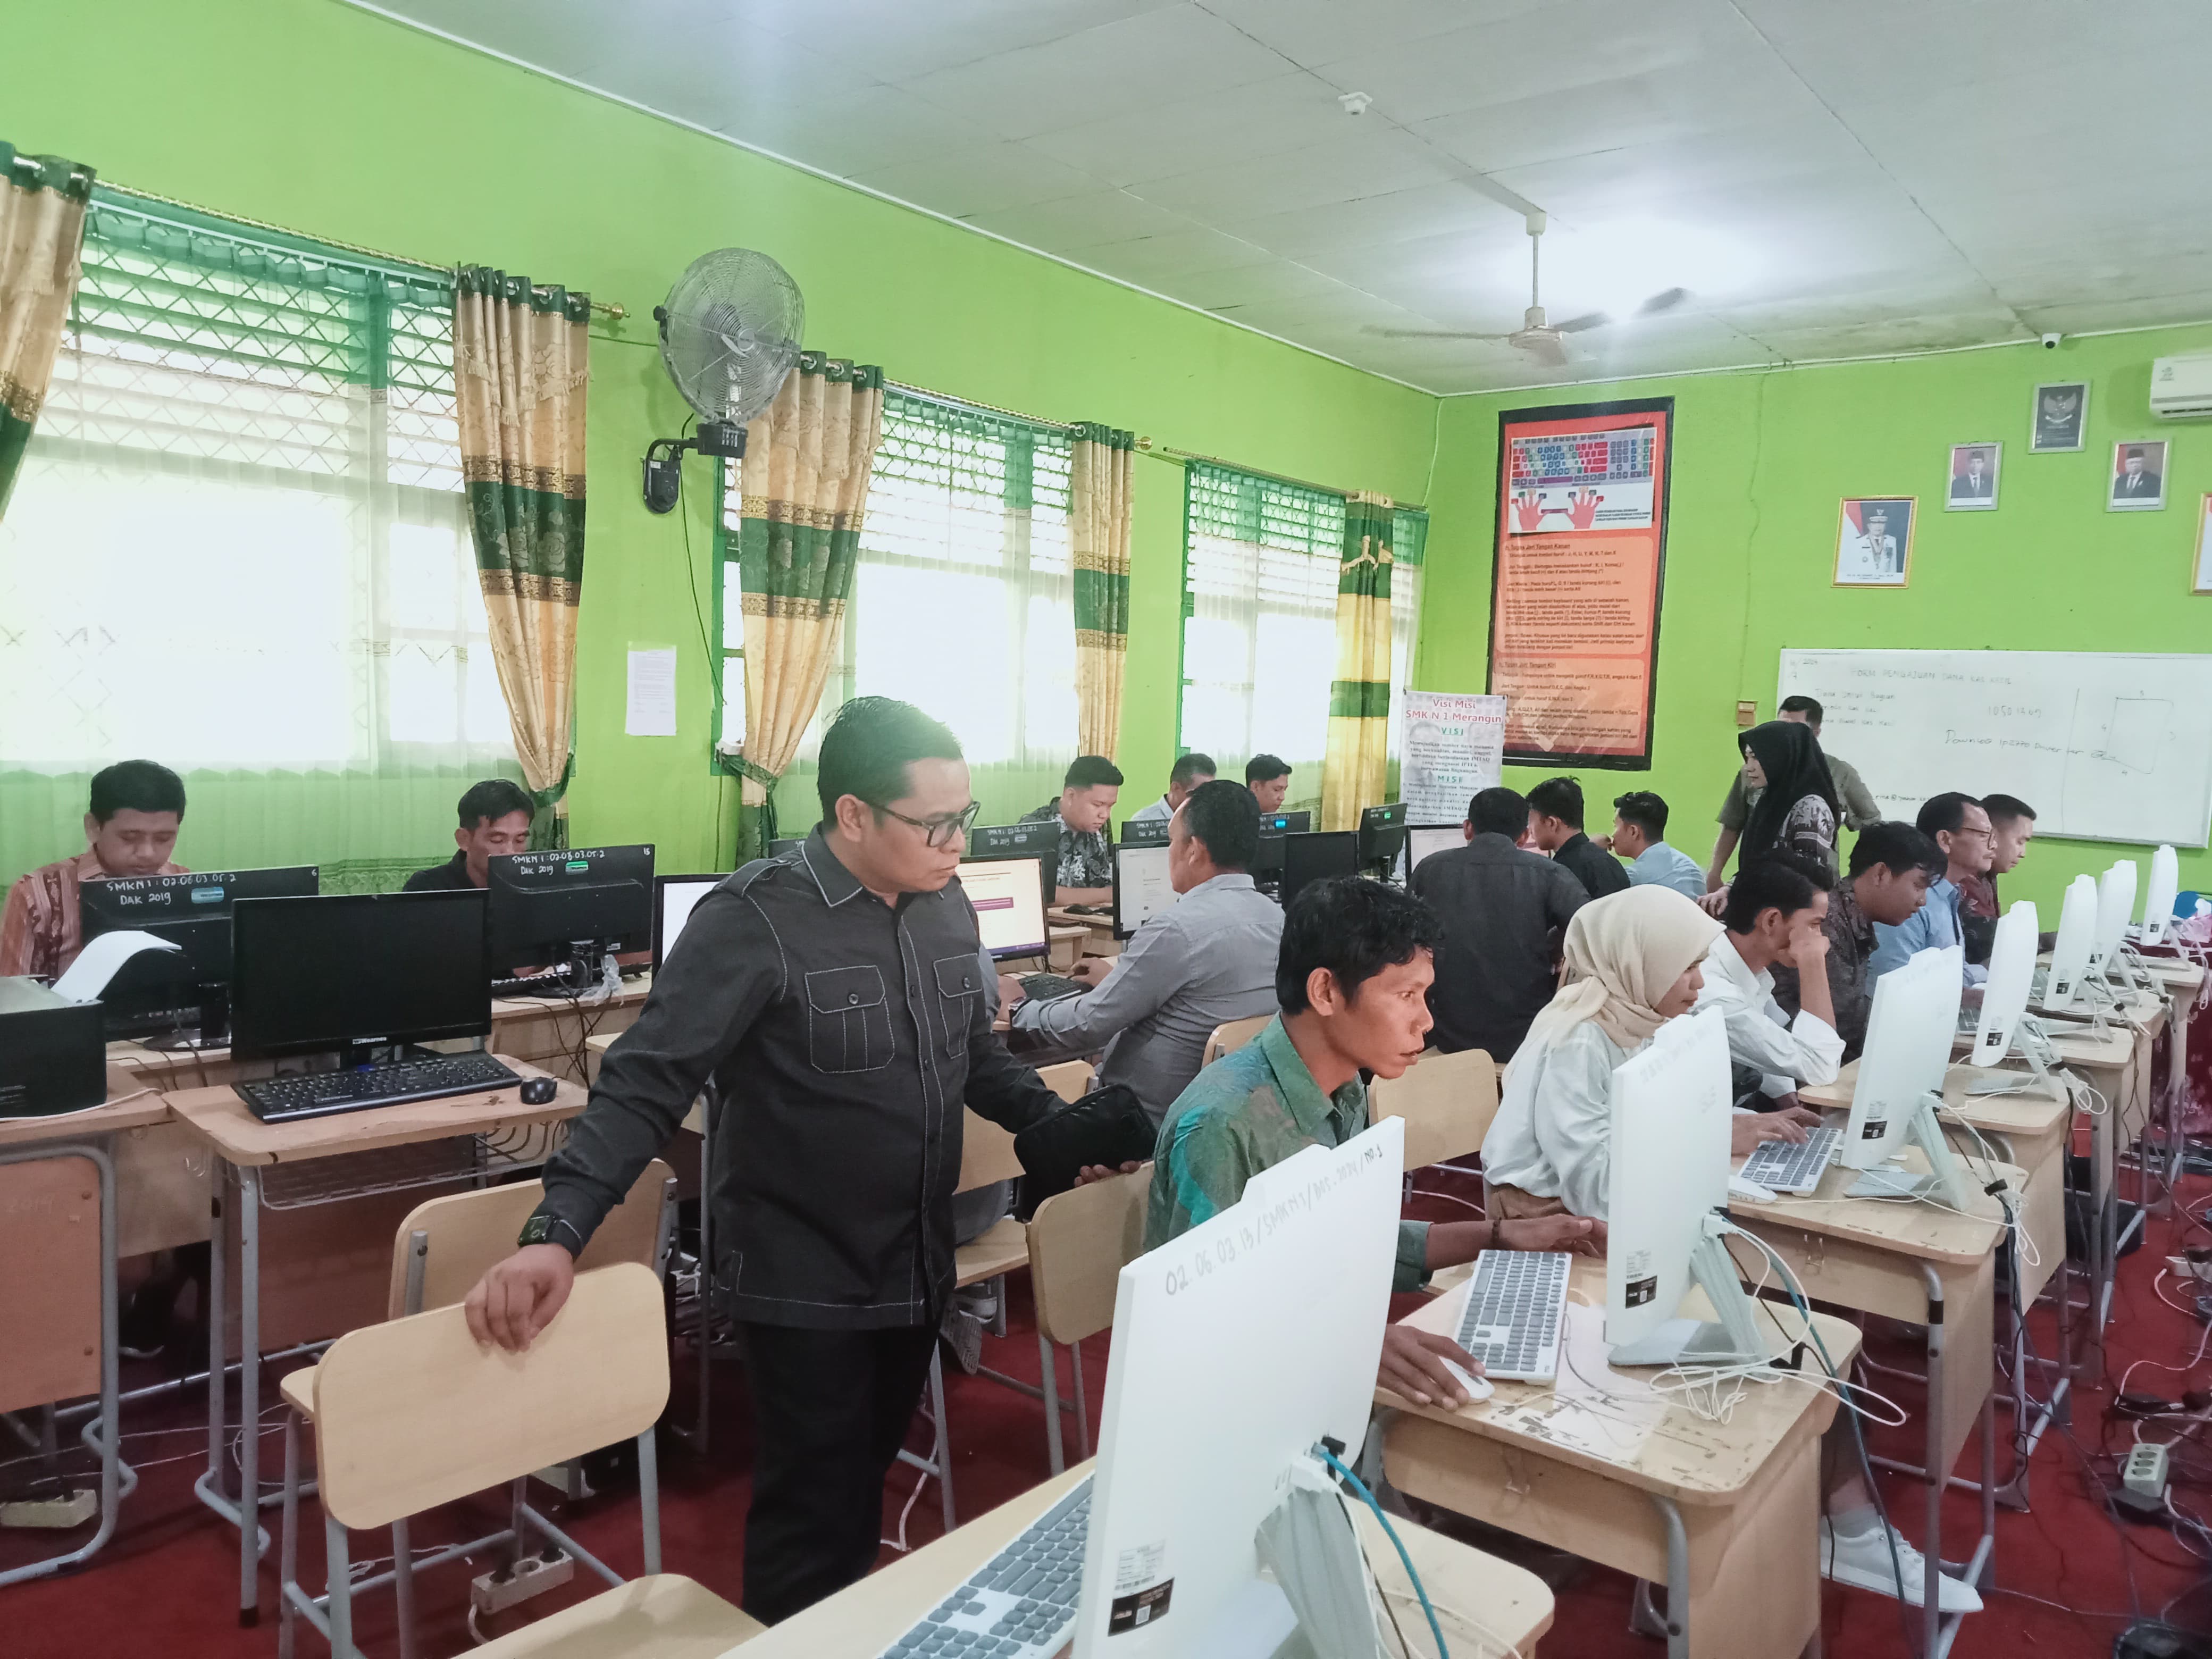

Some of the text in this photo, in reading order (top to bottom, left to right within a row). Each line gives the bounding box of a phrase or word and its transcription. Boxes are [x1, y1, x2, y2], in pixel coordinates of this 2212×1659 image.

[1882, 669, 1936, 680] PENGAJUAN
[1432, 699, 1476, 709] Visi Misi
[1405, 710, 1428, 718] SMK
[1452, 713, 1502, 724] Merangin
[311, 868, 317, 877] 6
[538, 865, 554, 876] 2019
[120, 892, 172, 906] DAK 2019
